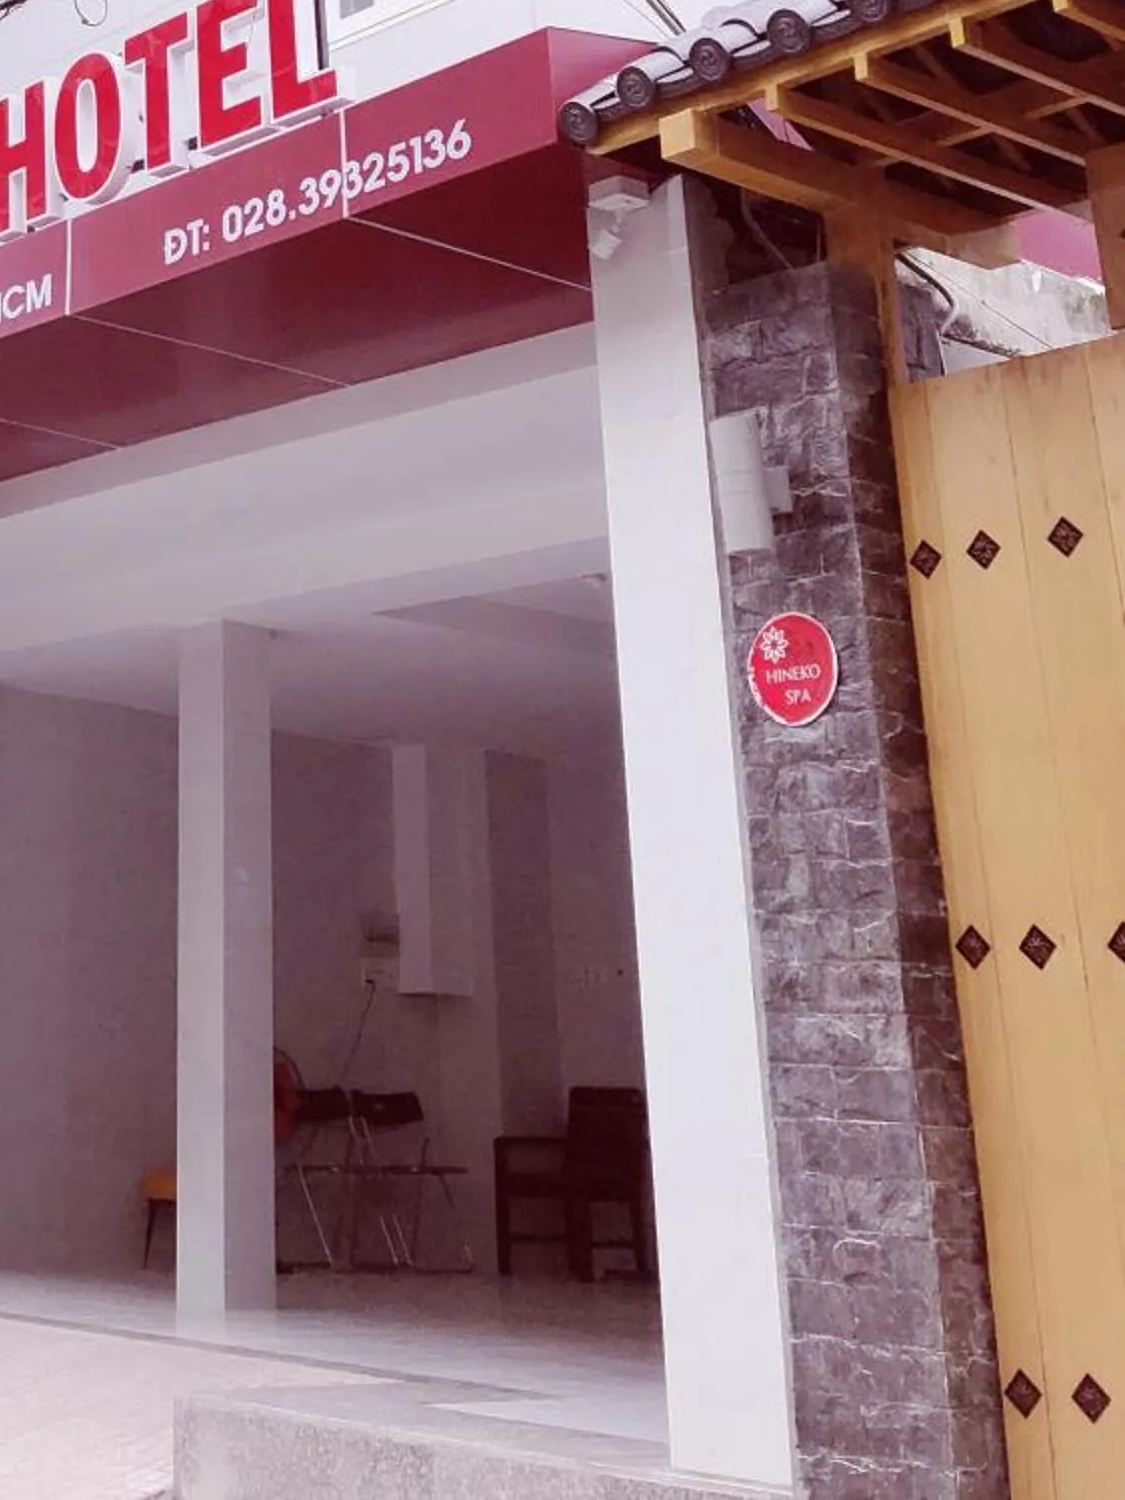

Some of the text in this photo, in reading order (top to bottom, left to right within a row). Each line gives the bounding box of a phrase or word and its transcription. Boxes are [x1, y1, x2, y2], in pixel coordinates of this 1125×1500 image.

[163, 118, 473, 265] ĐT: 028.39325136
[765, 663, 823, 685] HINEKO
[785, 688, 812, 705] SPA
